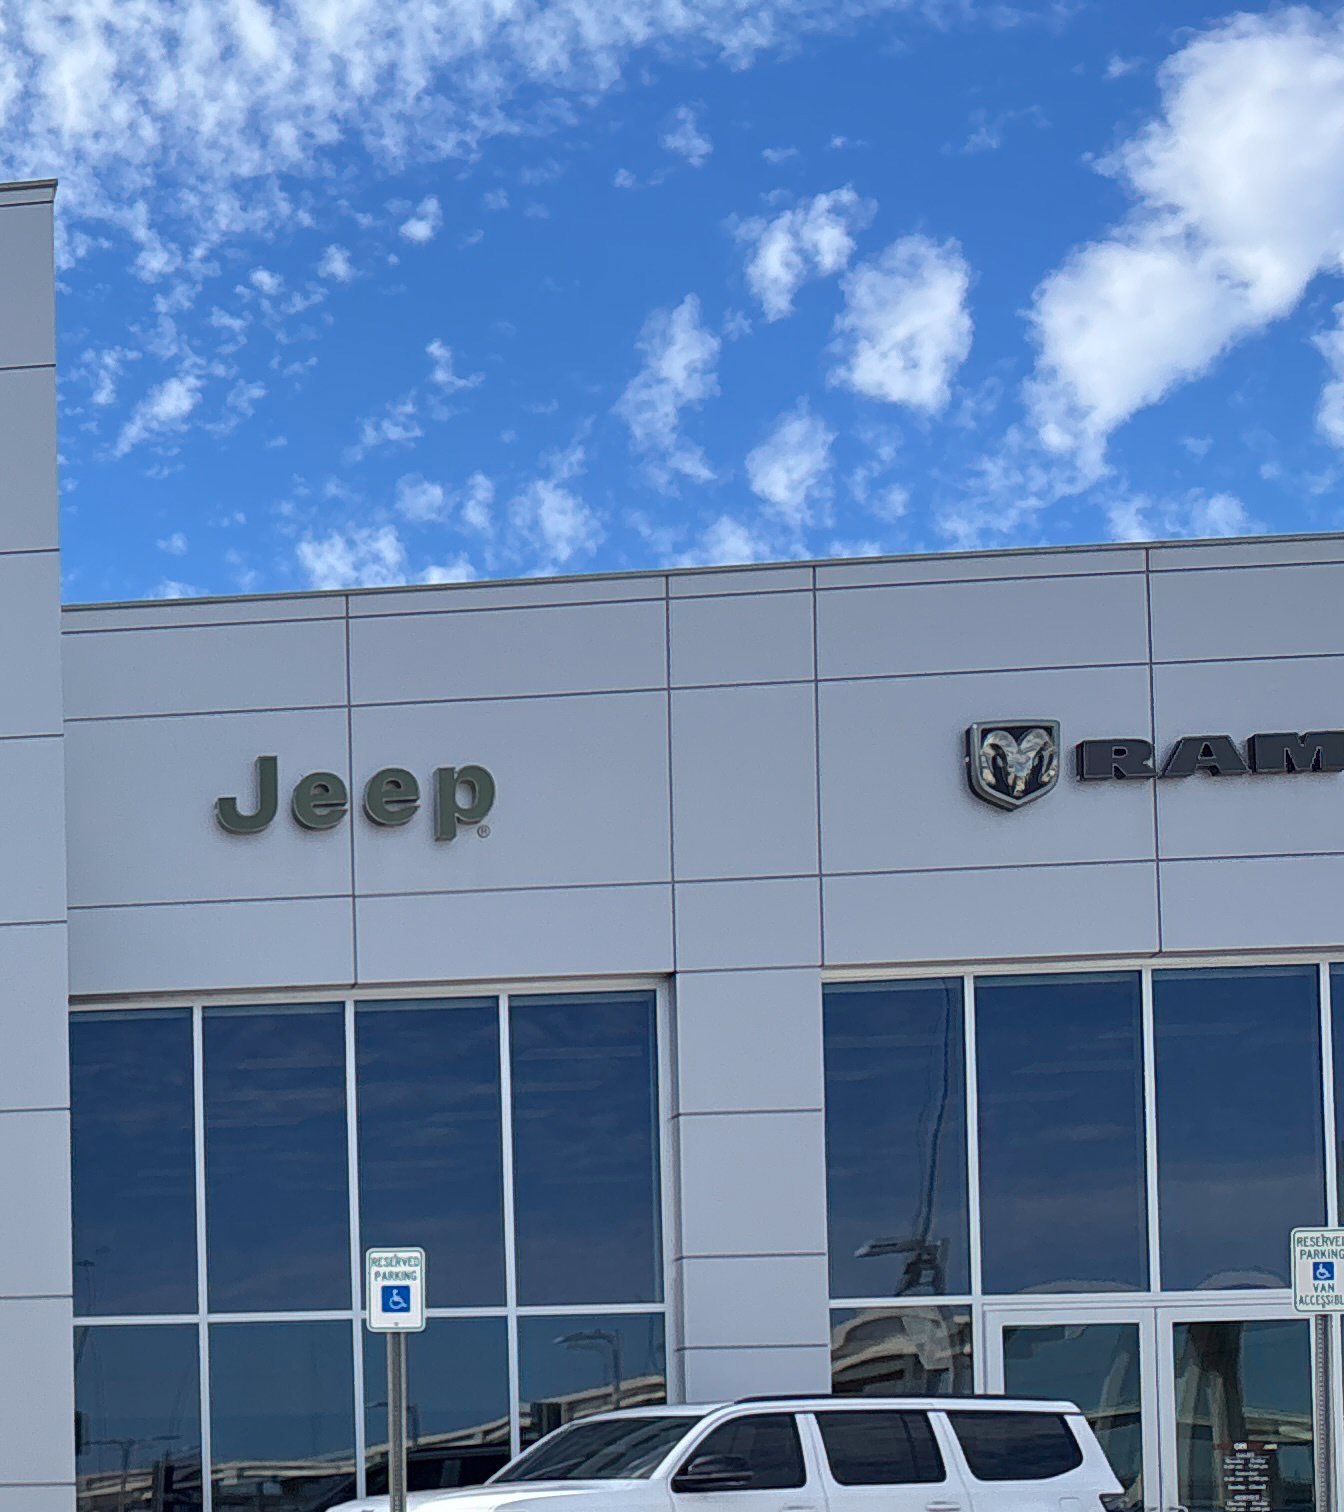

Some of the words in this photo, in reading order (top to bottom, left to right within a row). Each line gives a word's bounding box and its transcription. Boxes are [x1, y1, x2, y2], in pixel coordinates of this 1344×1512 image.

[1076, 730, 1344, 781] RAM
[213, 755, 496, 842] Jeep
[1300, 1249, 1344, 1260] PARKING
[371, 1256, 421, 1267] RESERVED
[374, 1271, 417, 1281] PARKING
[1313, 1283, 1335, 1293] VAN
